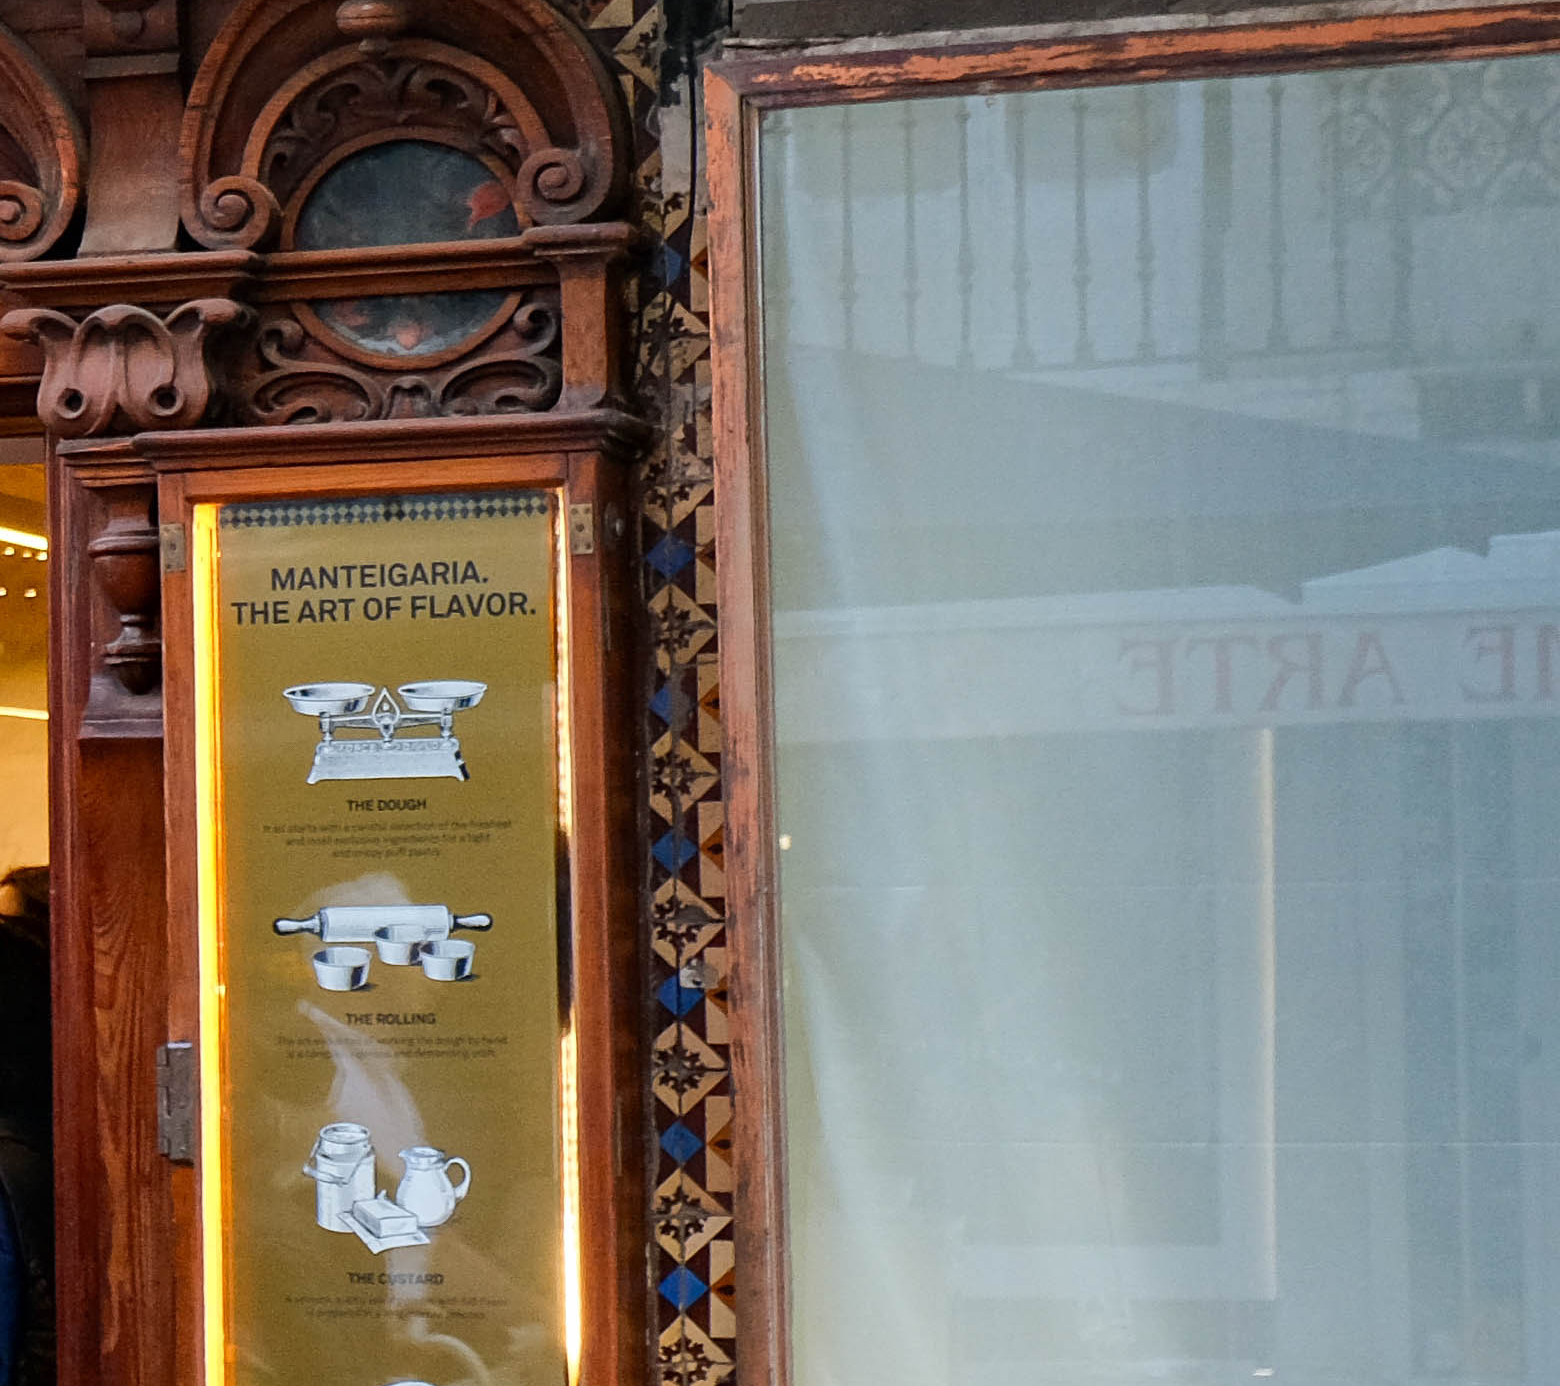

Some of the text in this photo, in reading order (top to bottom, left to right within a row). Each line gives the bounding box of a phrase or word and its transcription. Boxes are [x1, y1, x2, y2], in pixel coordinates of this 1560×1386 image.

[270, 560, 490, 593] MANTEIGARIA.
[230, 592, 537, 625] THE ART OF FLAVOR.
[346, 798, 427, 812] THE DOUGH
[346, 1012, 437, 1025] THE ROLLING
[346, 1271, 444, 1286] THE CUSTARD
